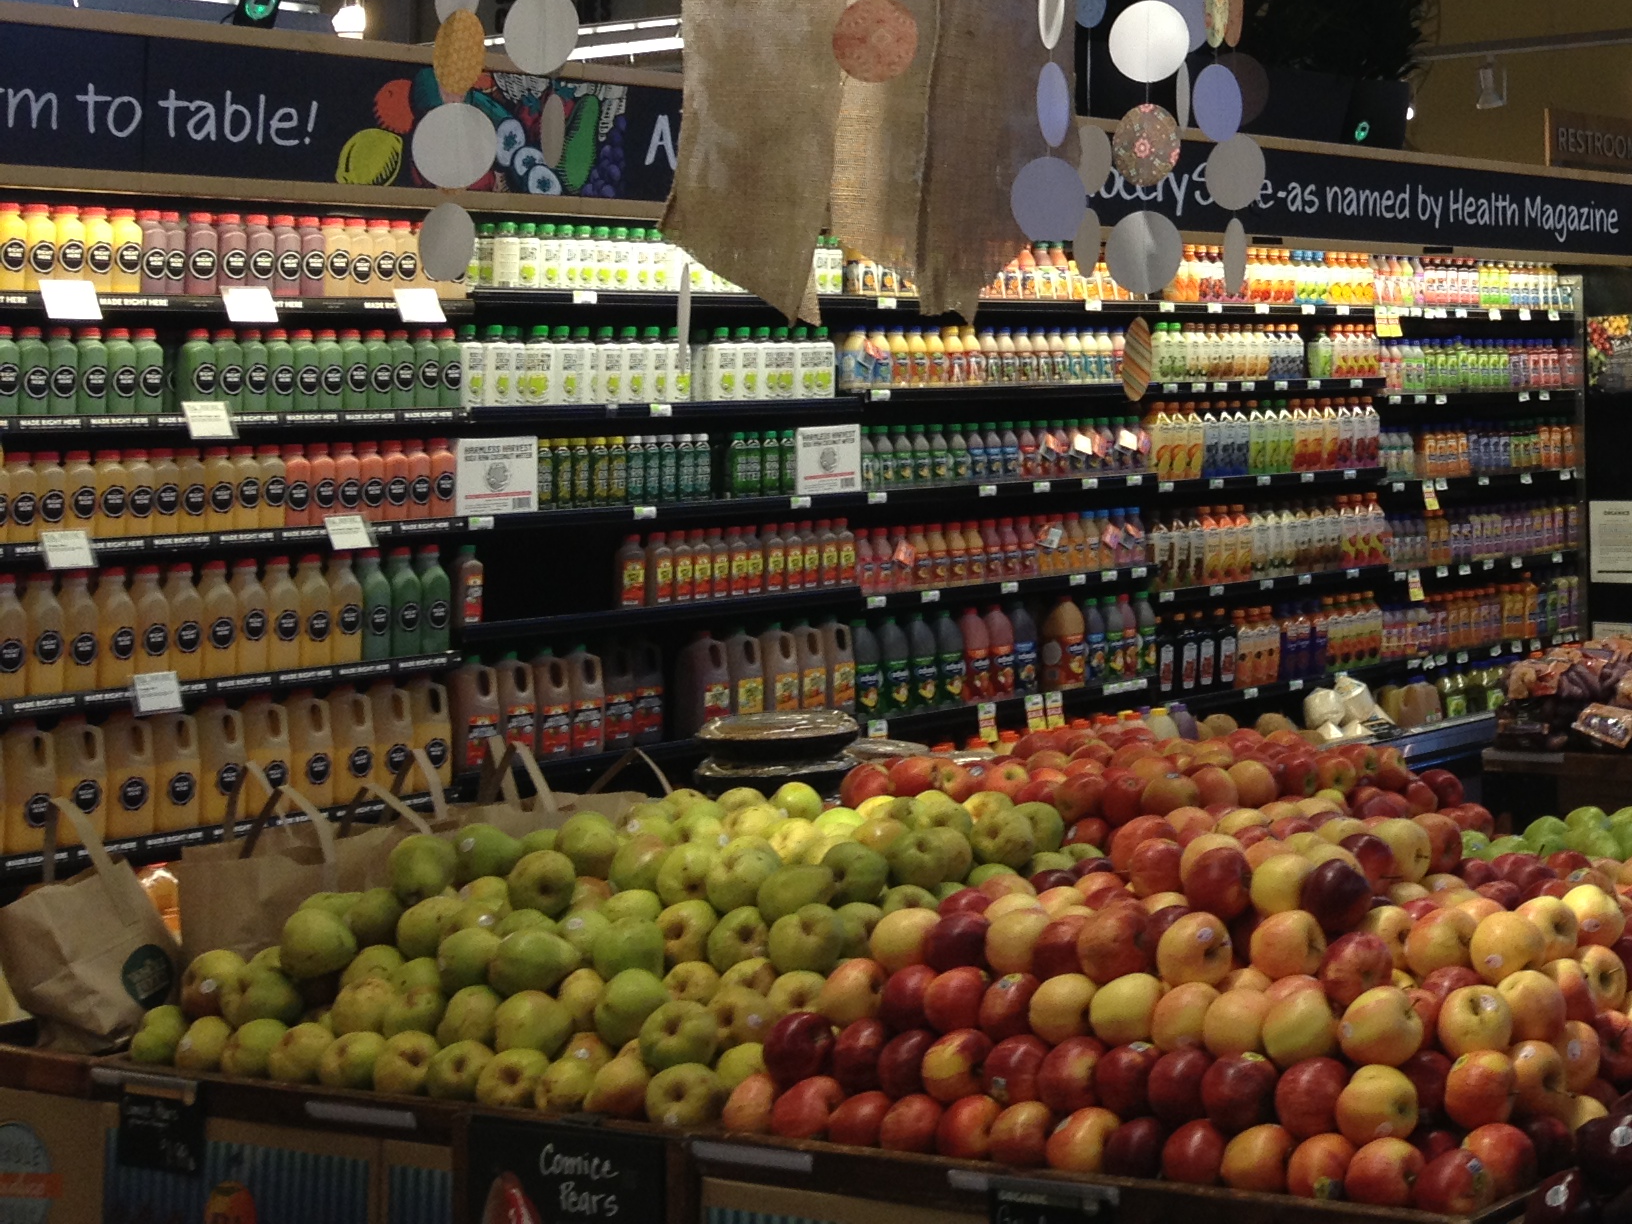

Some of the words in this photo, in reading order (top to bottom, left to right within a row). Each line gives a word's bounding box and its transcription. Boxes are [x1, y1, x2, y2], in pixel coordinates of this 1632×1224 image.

[77, 83, 142, 138] to
[158, 88, 319, 147] table!
[1326, 179, 1411, 219] named
[1417, 180, 1444, 230] by
[1448, 183, 1519, 226] Health
[1524, 187, 1620, 243] Magazine
[539, 1142, 620, 1180] Comice
[558, 1180, 620, 1217] Pears
